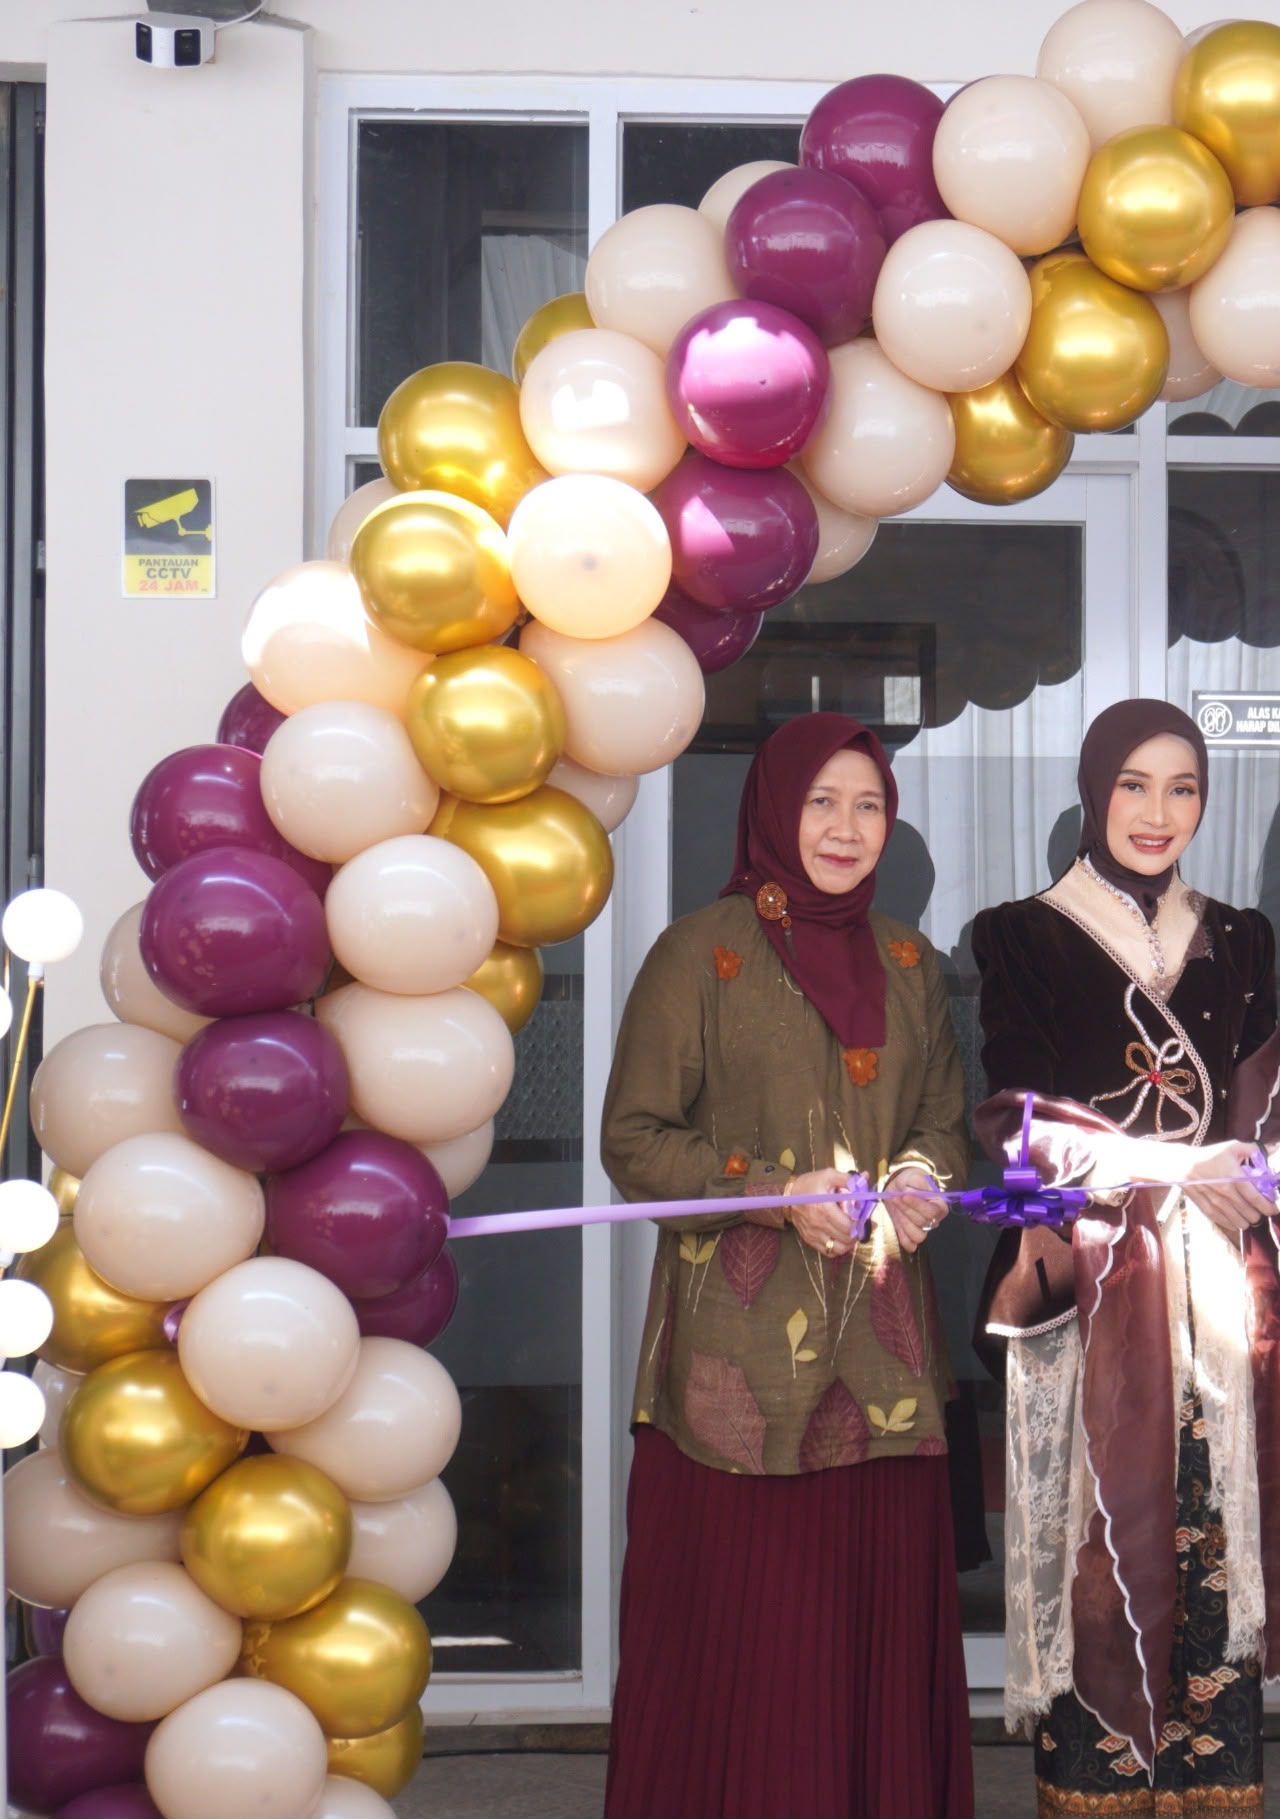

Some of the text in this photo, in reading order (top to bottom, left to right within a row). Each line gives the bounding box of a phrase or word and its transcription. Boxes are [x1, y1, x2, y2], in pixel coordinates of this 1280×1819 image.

[138, 558, 199, 567] PANTAUAN
[146, 567, 192, 579] CCTV
[138, 580, 159, 591] 24
[164, 580, 199, 591] JAM
[1247, 706, 1271, 719] ALAS
[1236, 720, 1266, 733] HARAP
